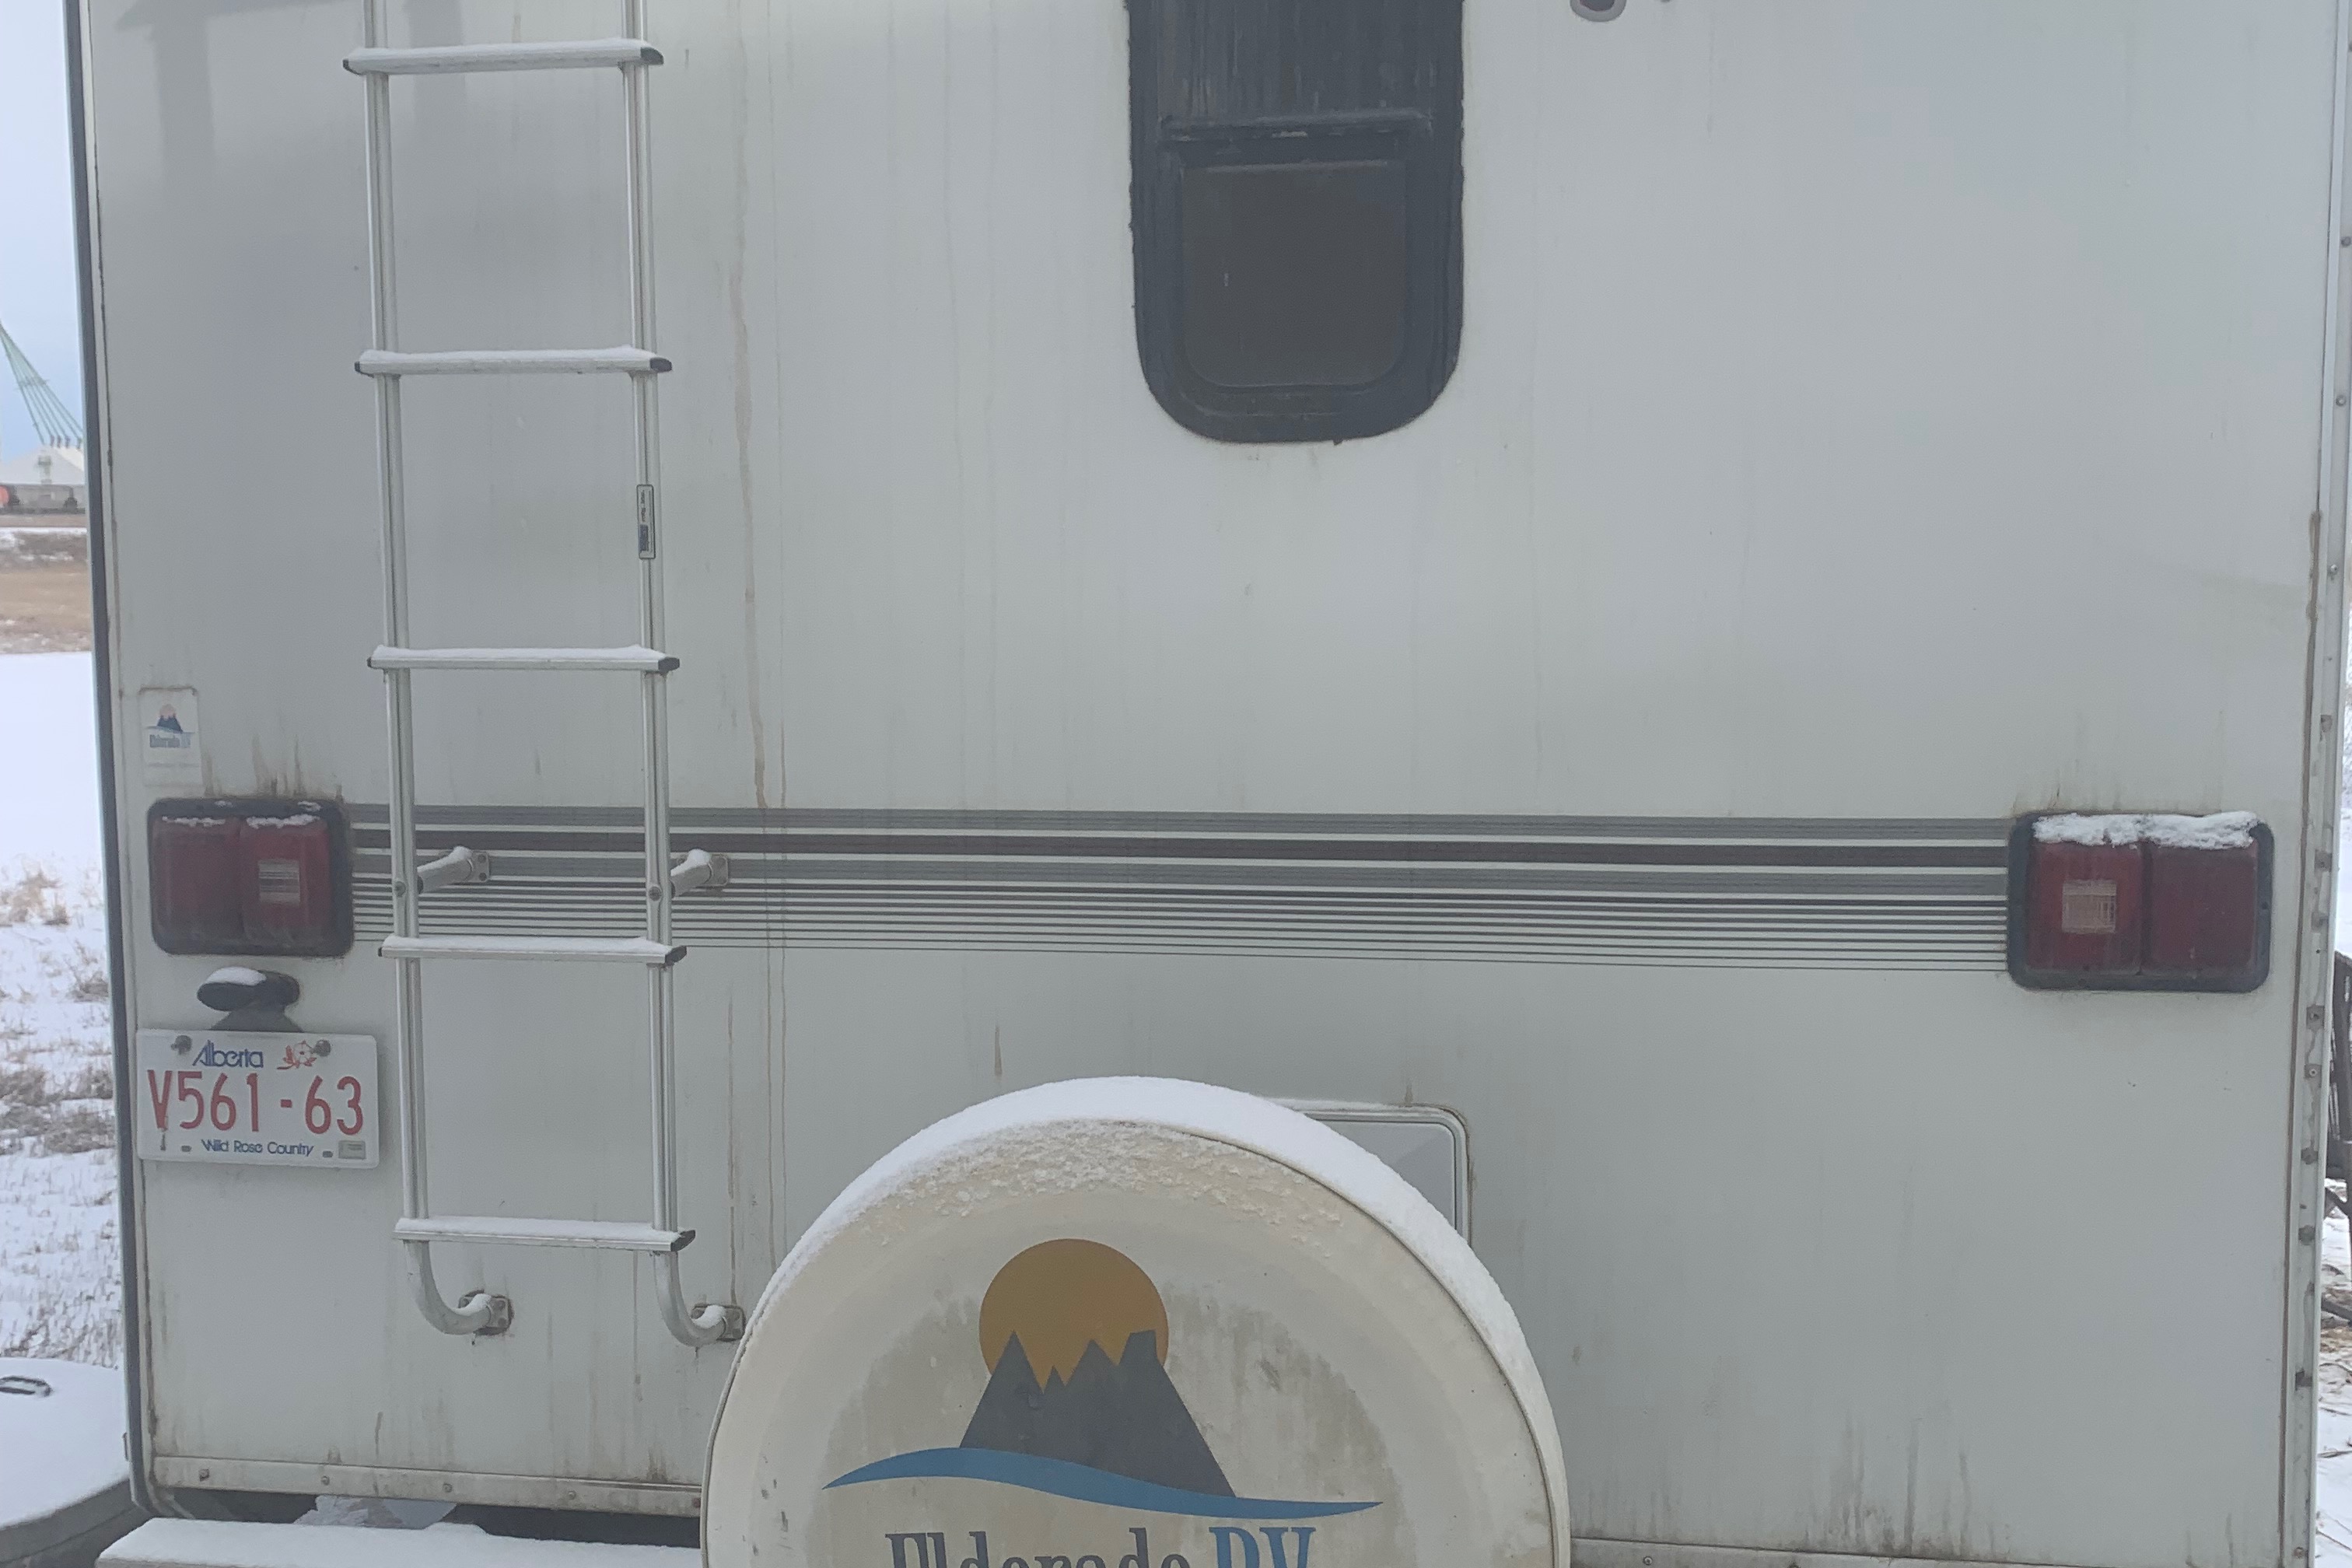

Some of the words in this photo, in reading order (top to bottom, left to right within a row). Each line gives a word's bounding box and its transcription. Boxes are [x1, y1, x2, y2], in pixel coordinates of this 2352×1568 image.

[192, 1039, 264, 1068] Alberta
[201, 1139, 229, 1153] Wild
[233, 1139, 263, 1153] Rose
[267, 1141, 314, 1157] Country
